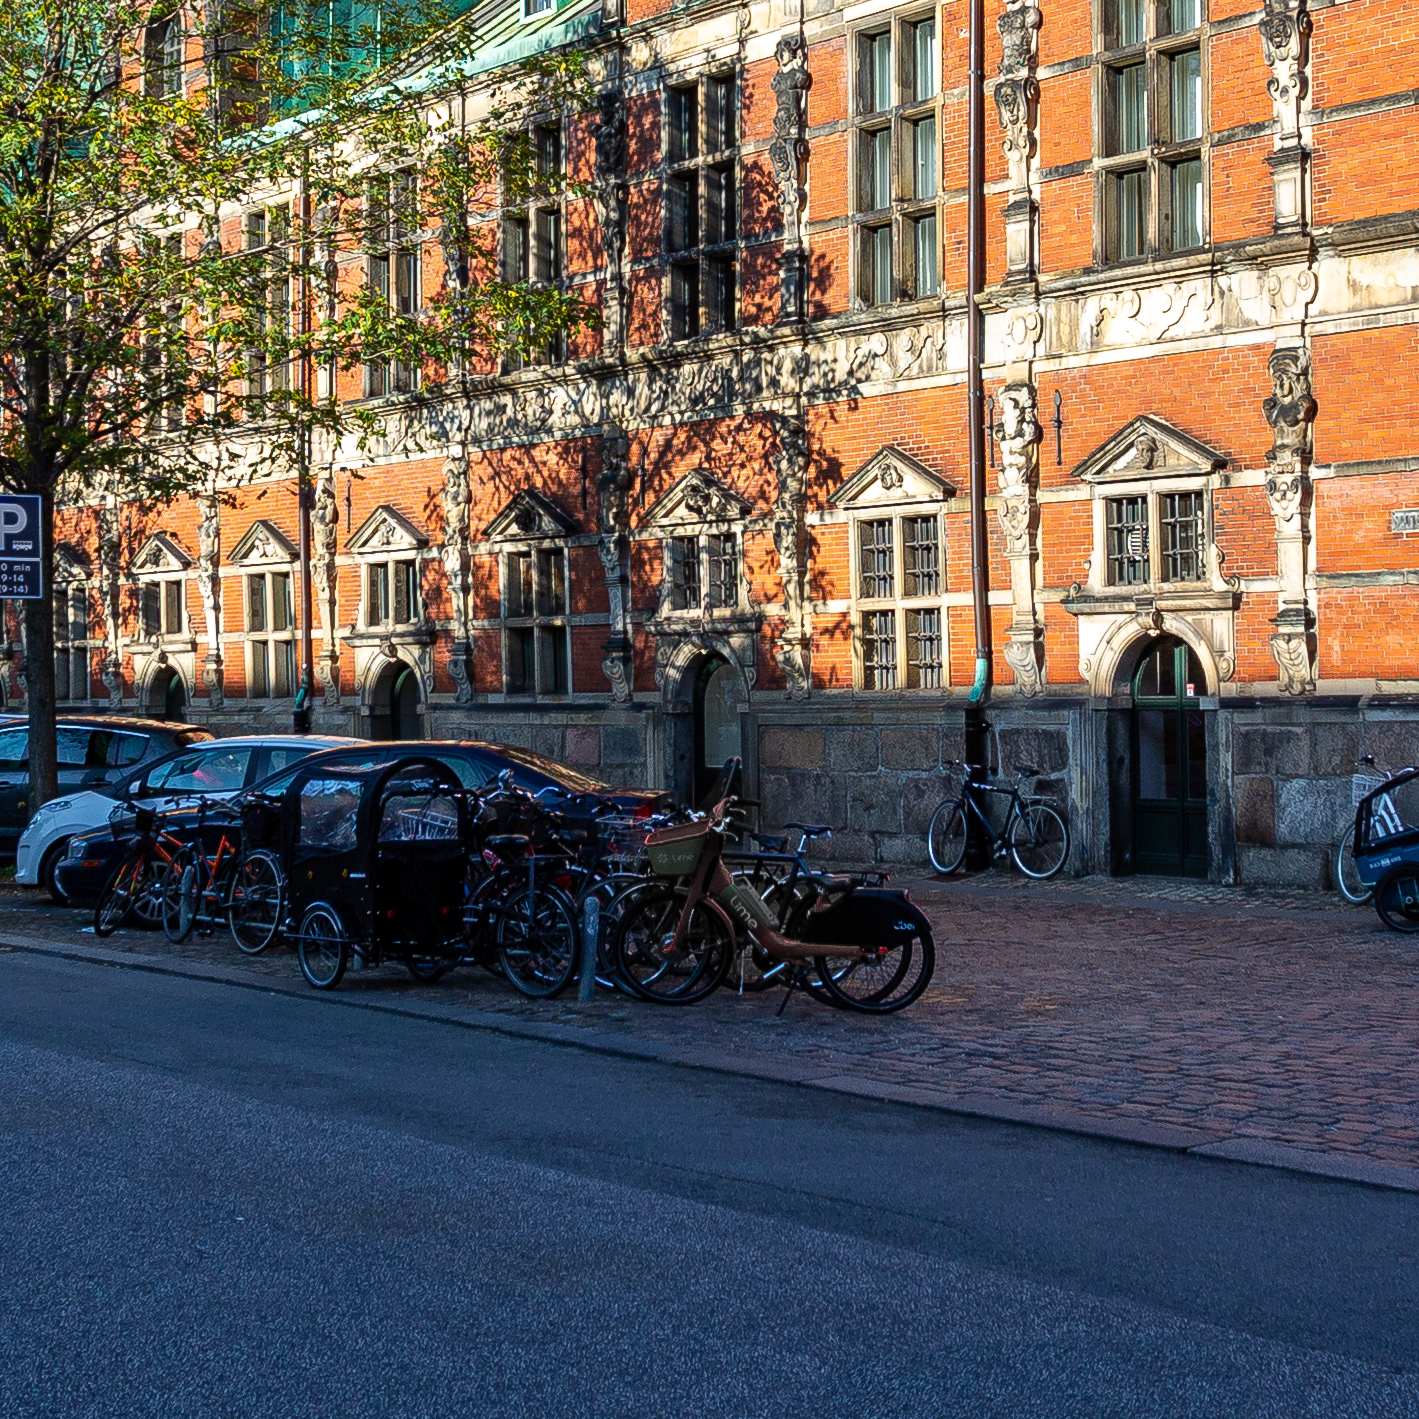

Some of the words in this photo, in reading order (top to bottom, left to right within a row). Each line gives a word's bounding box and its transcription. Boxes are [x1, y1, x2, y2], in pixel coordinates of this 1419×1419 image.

[13, 563, 31, 572] min
[1, 573, 24, 582] 9-14
[730, 895, 758, 930] Lime
